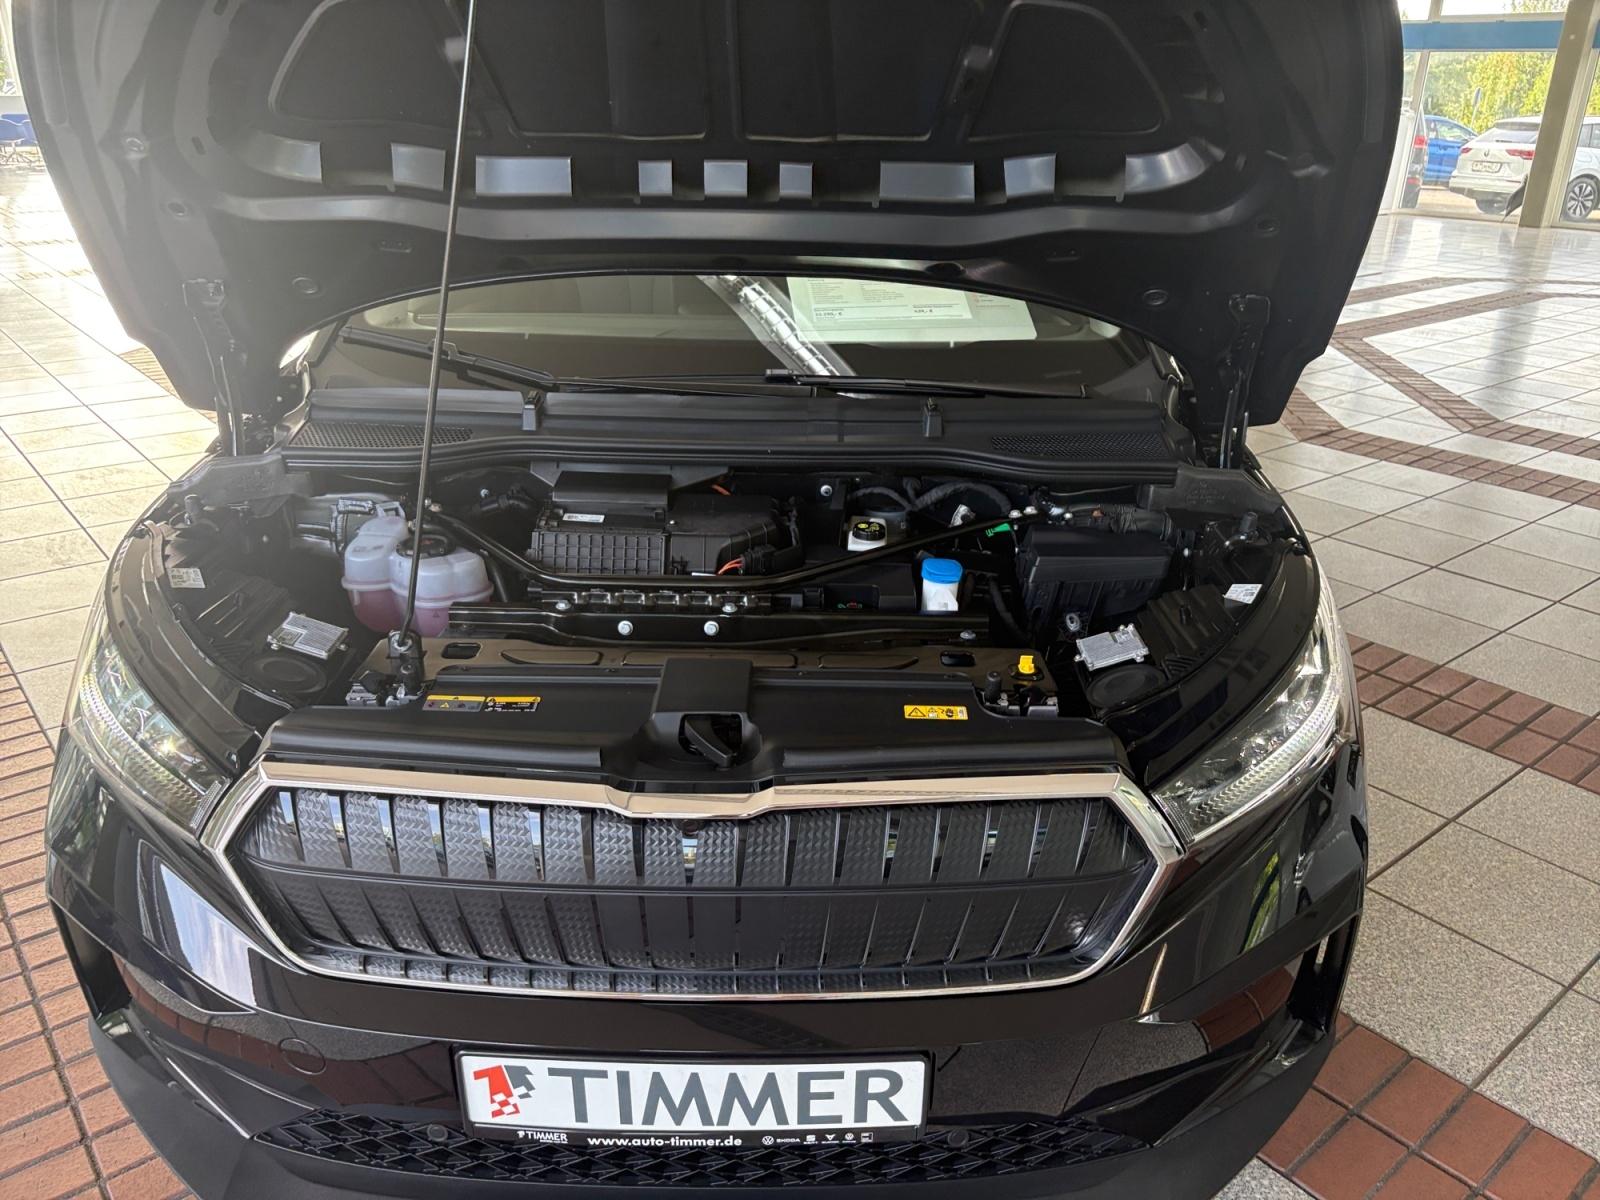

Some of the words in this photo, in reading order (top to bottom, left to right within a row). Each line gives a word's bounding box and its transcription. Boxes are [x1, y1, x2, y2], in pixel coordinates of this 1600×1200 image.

[547, 1067, 909, 1126] TIMMER
[526, 1131, 568, 1141] TIMMER
[586, 1135, 743, 1147] www.auto-timmer.de
